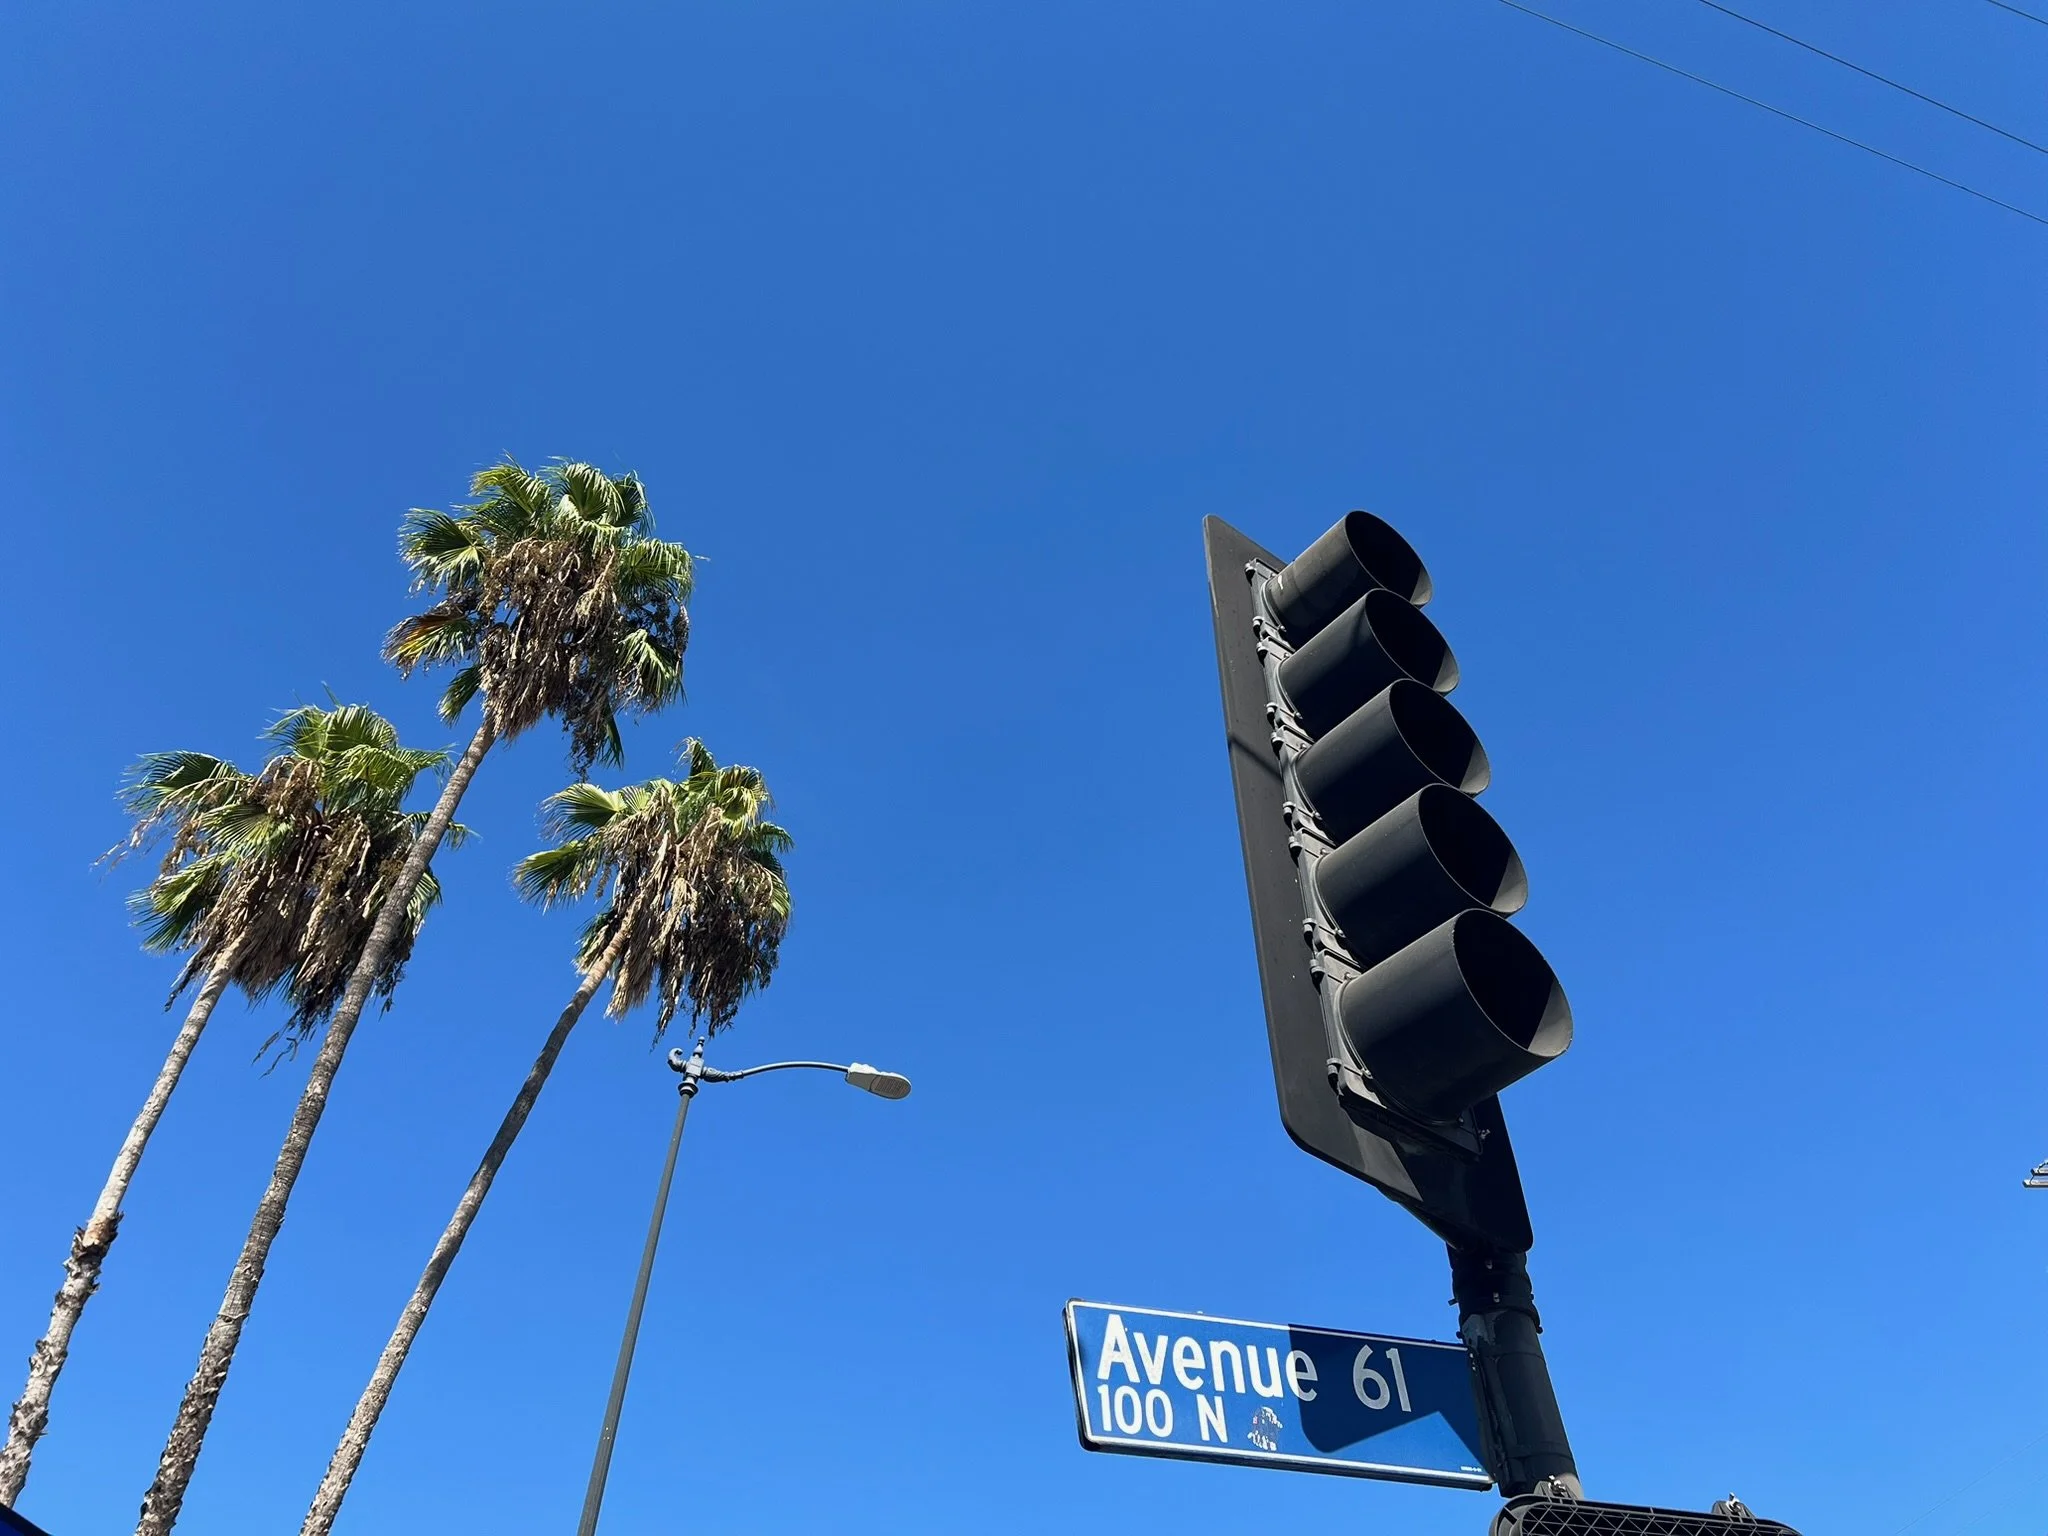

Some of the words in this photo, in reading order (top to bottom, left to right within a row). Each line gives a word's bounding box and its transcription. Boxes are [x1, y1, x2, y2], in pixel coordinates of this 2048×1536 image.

[1097, 1314, 1318, 1401] Avenue
[1353, 1345, 1412, 1413] 61
[1097, 1384, 1174, 1437] 100
[1197, 1394, 1228, 1443] N
